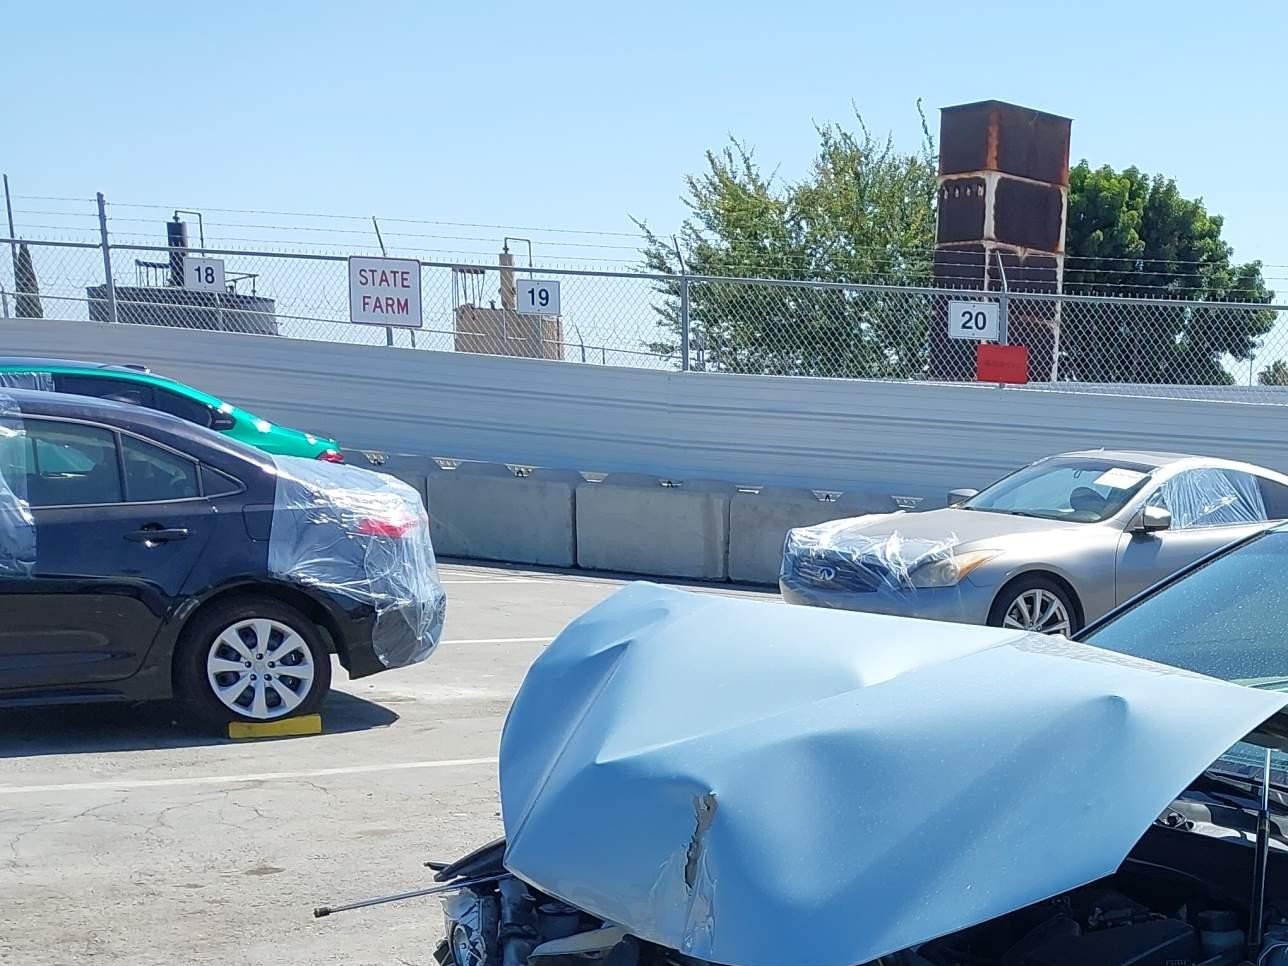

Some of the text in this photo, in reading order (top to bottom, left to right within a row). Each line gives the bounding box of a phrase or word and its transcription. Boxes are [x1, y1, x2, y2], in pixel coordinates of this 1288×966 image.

[194, 265, 215, 284] 18
[359, 268, 411, 289] STATE
[362, 295, 409, 315] FARM
[527, 287, 550, 307] 19
[960, 310, 987, 331] 20
